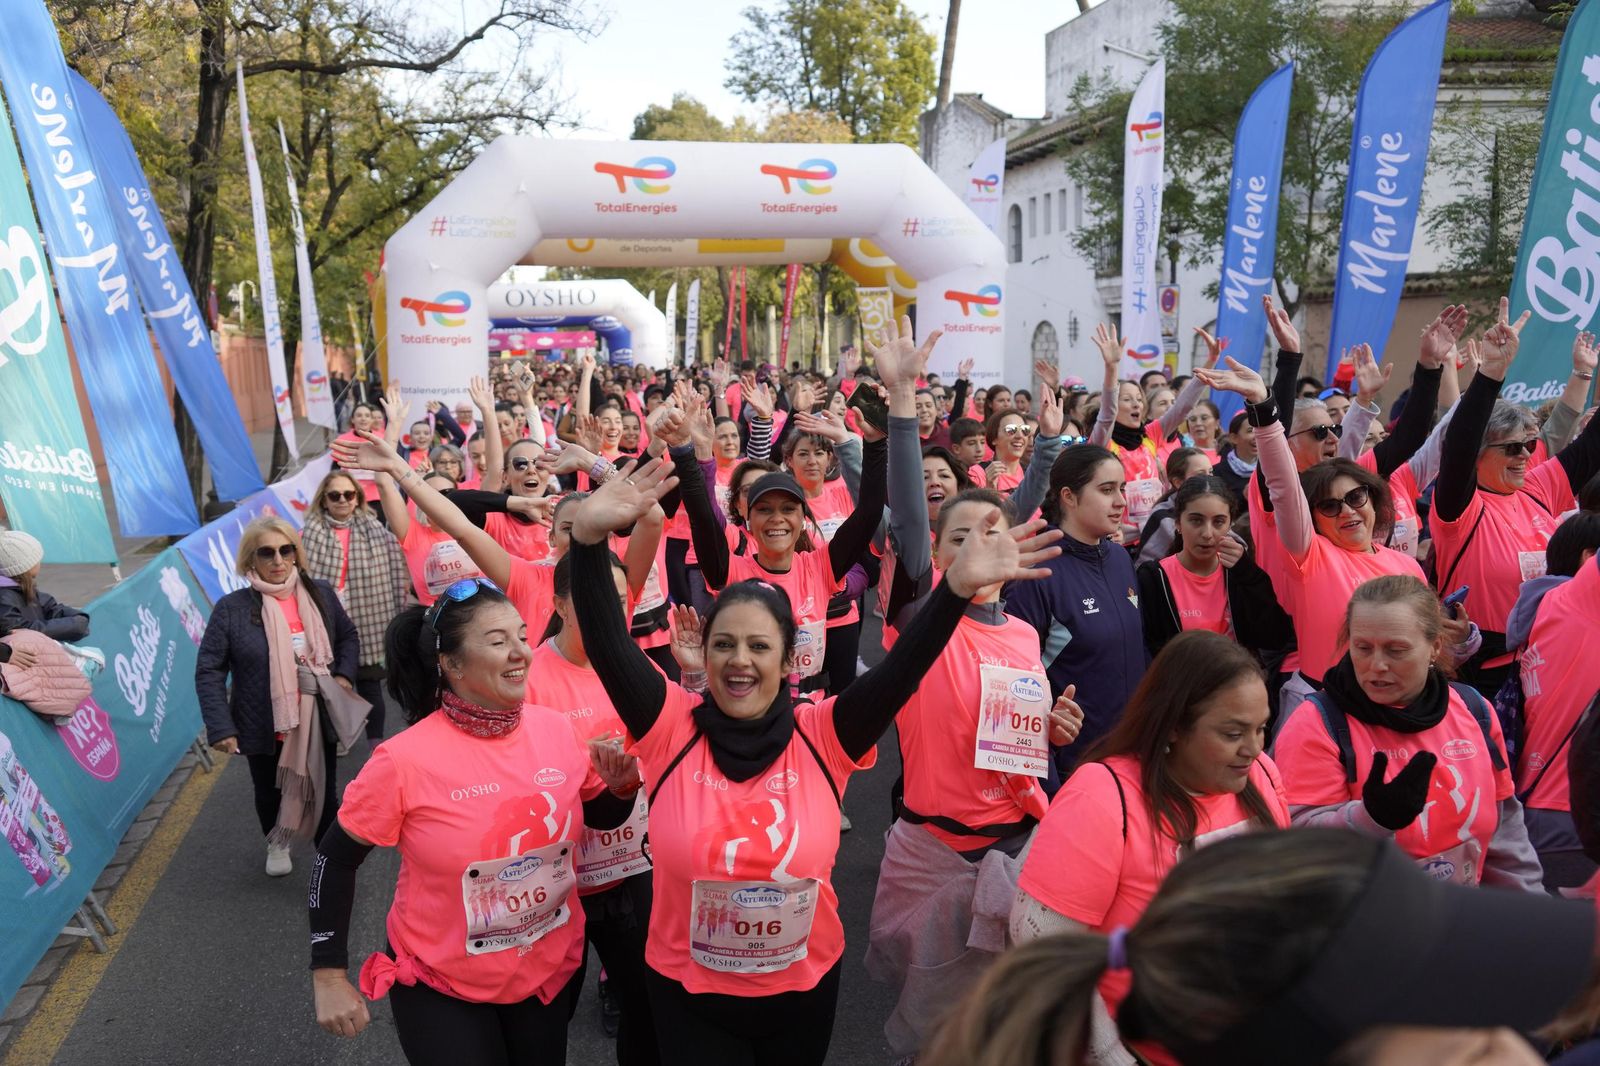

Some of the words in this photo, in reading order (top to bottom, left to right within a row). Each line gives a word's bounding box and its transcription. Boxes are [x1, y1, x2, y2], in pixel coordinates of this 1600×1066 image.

[594, 202, 678, 215] TotalEnergies
[760, 203, 838, 215] TotalEnergies
[1346, 132, 1411, 294] Marlene
[1223, 175, 1273, 314] Marlene
[505, 288, 596, 308] OYSHO
[401, 334, 472, 346] TotalEnergies
[439, 560, 463, 574] 016
[1010, 714, 1042, 734] 016
[1016, 737, 1032, 747] 2443
[86, 738, 114, 768] ESPAÑA
[987, 755, 1014, 767] OYSHO
[450, 782, 501, 802] OYSHO
[601, 825, 634, 847] 016
[611, 847, 628, 857] 1532
[583, 871, 613, 883] OYSHO
[506, 886, 548, 913] 016
[703, 891, 729, 902] SUMA
[734, 919, 782, 936] 016
[707, 945, 735, 957] CARRERA
[747, 942, 765, 950] 905
[703, 955, 742, 968] OYSHO
